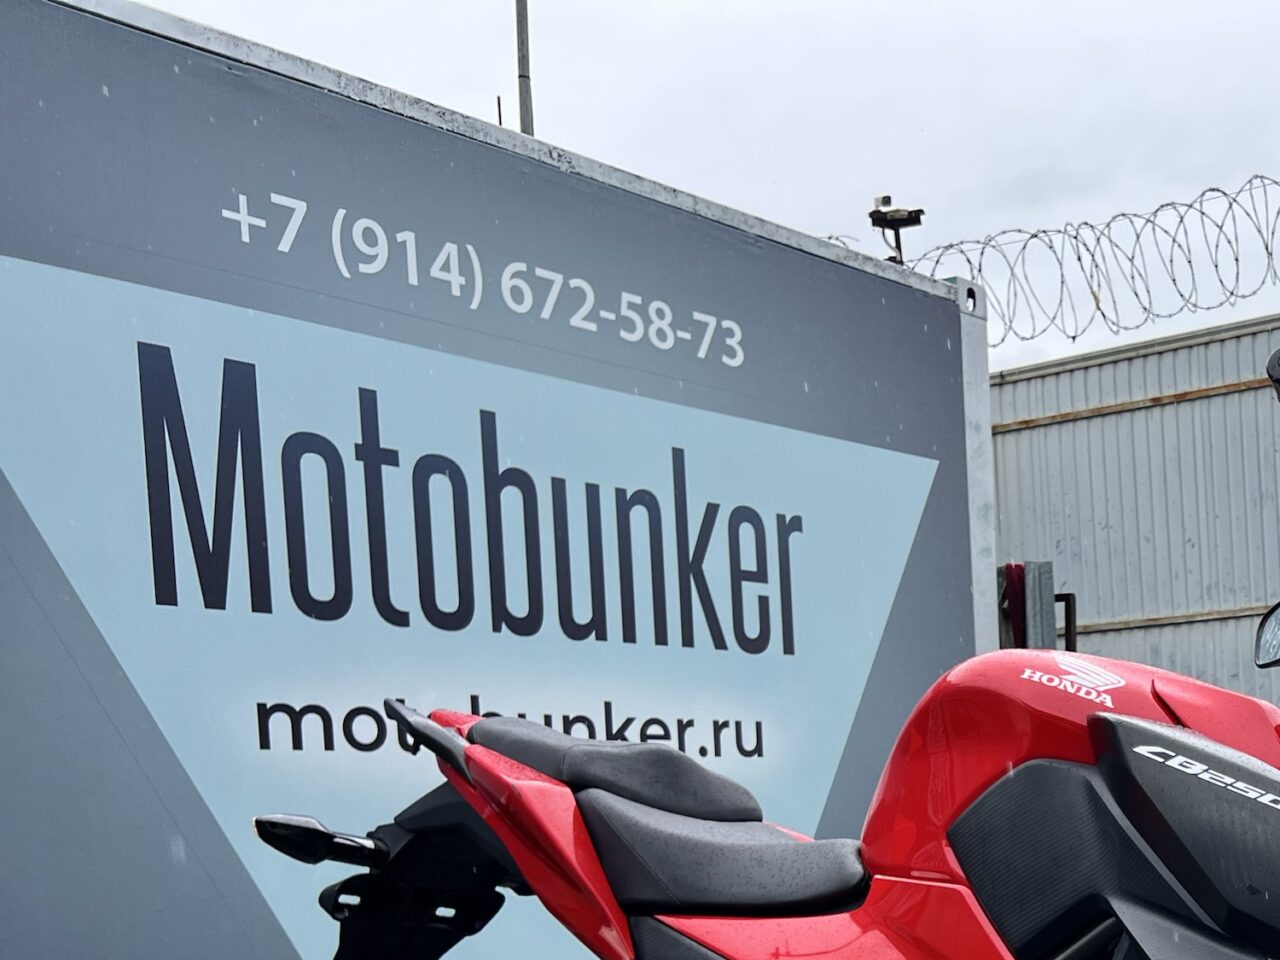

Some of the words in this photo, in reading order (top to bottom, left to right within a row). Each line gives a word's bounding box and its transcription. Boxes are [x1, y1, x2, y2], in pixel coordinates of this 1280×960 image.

[221, 193, 308, 253] +7
[331, 208, 484, 310] (914)
[500, 261, 746, 368] 672-58-73
[136, 341, 804, 657] Motobunker
[1019, 668, 1114, 709] HONDA
